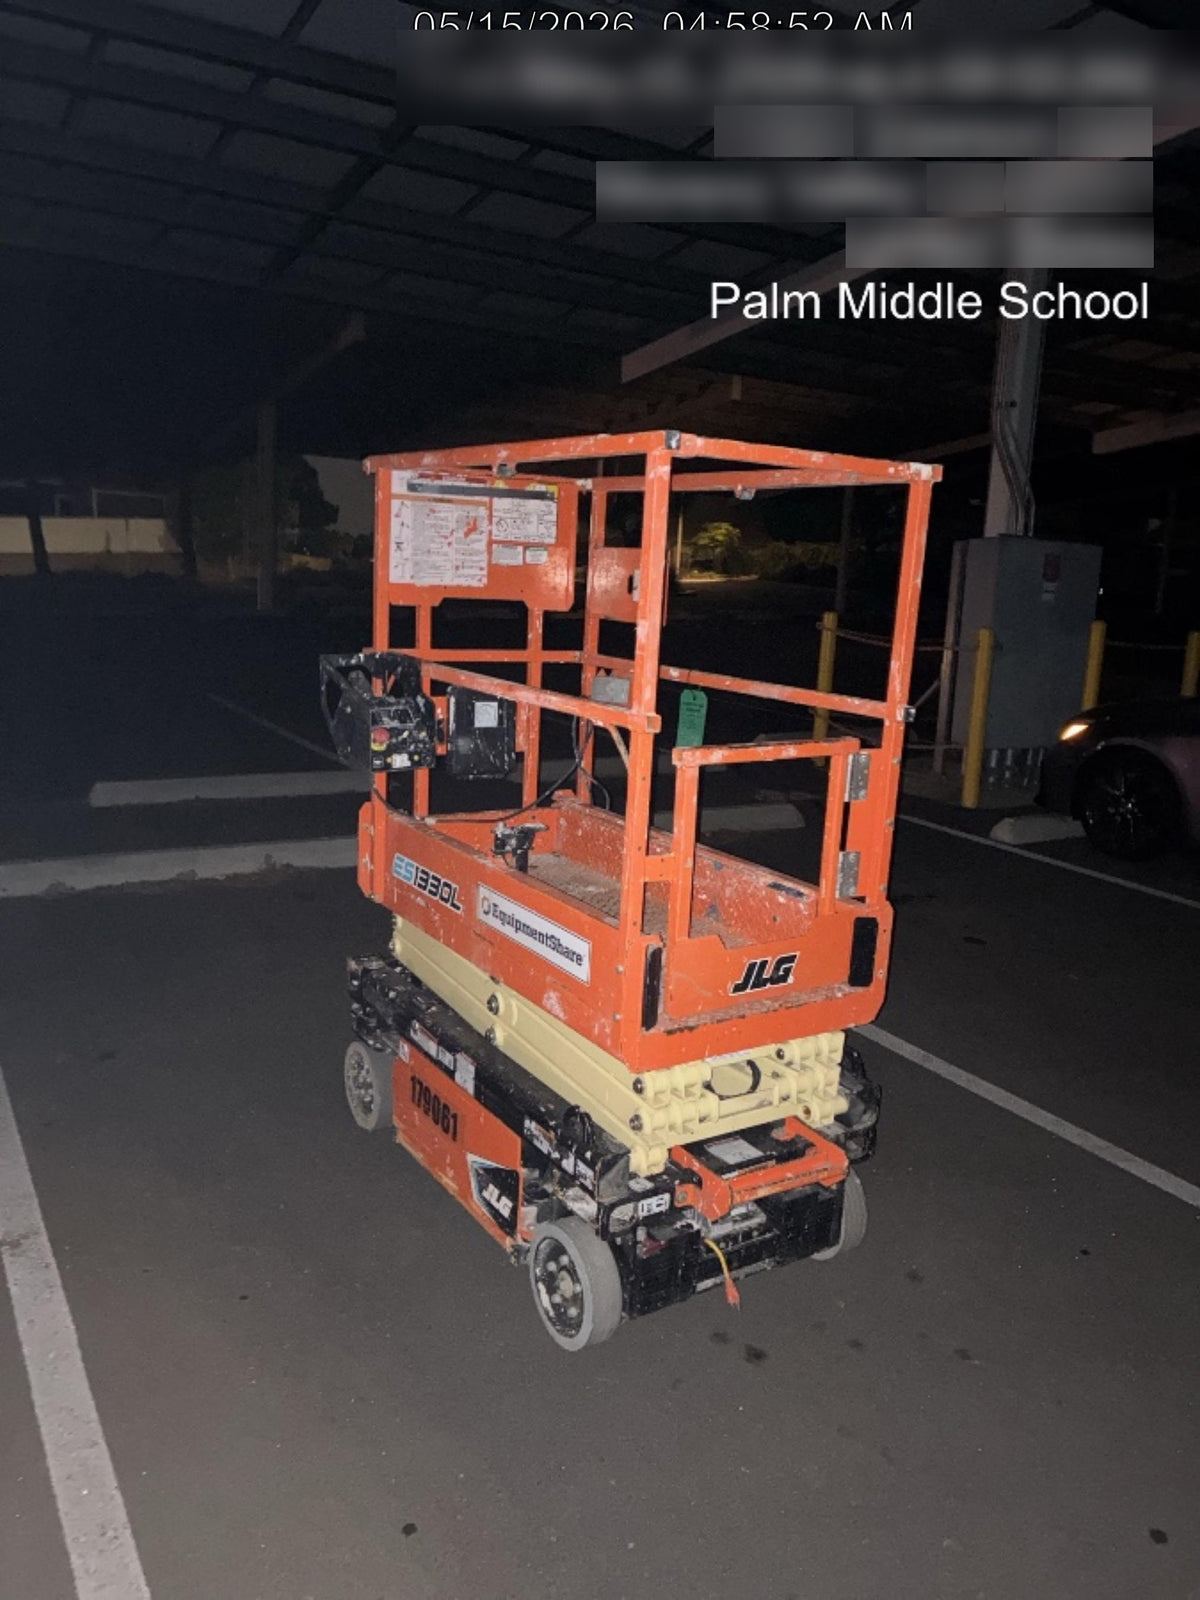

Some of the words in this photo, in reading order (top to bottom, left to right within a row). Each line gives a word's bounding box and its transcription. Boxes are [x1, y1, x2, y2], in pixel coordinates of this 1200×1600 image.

[393, 853, 462, 912] ES1330L
[491, 902, 584, 967] EquipmentShare
[730, 952, 799, 995] JLG
[410, 1075, 458, 1142] 179061
[481, 1183, 513, 1220] JLG
